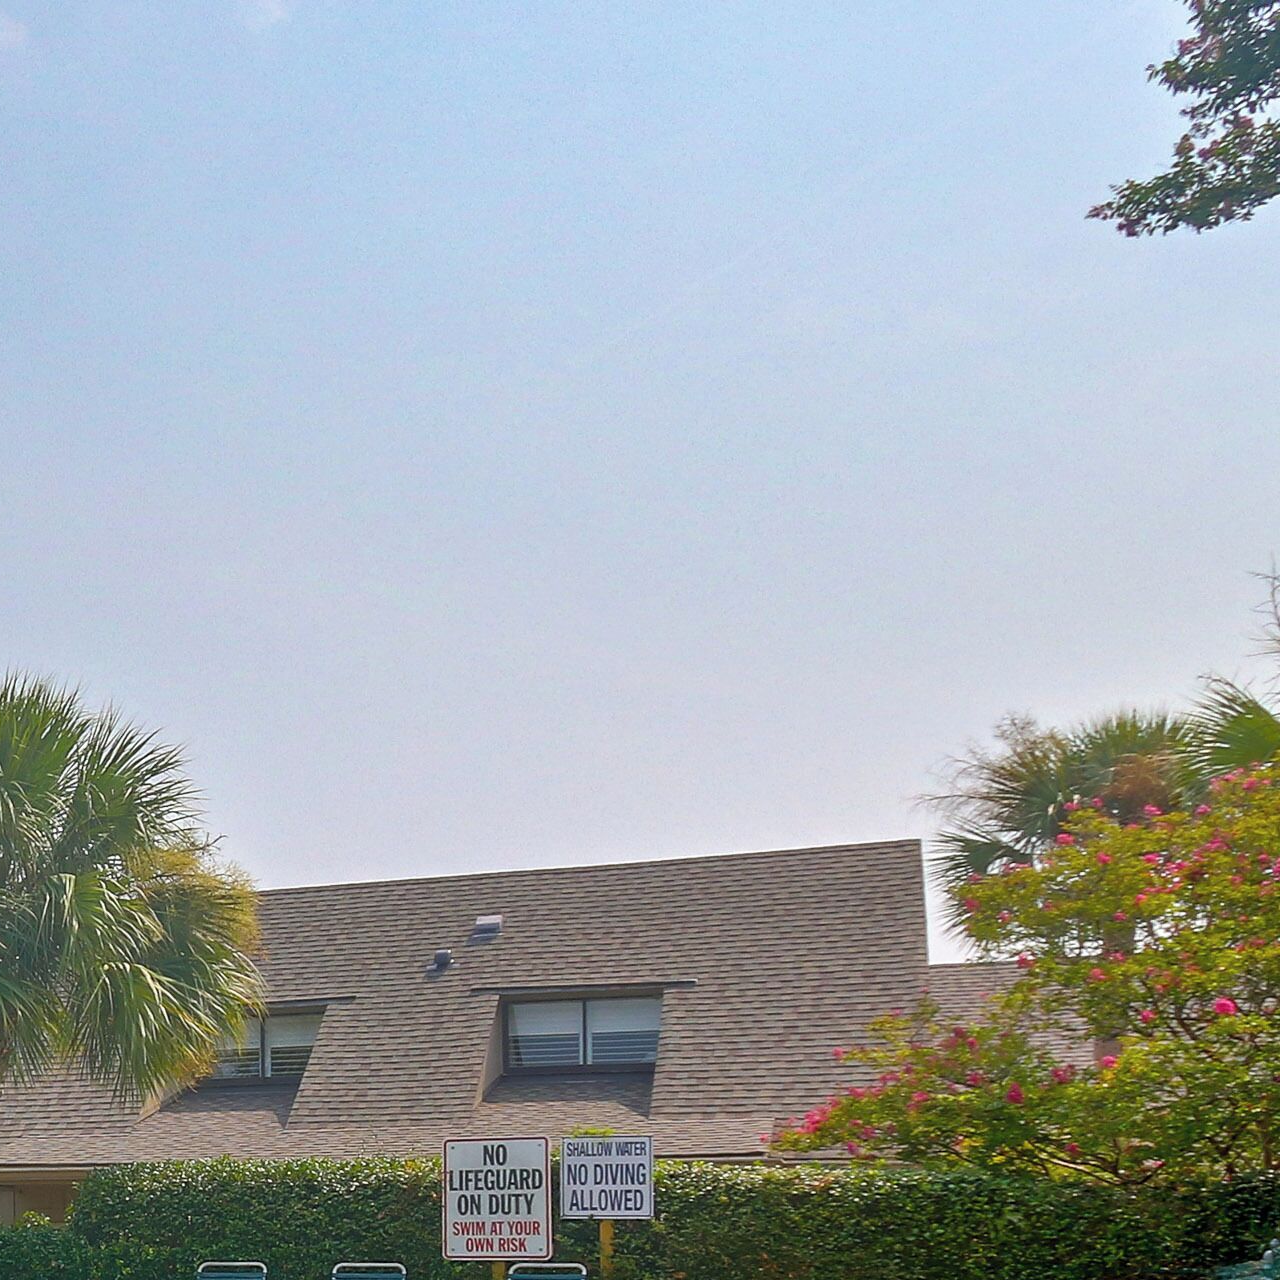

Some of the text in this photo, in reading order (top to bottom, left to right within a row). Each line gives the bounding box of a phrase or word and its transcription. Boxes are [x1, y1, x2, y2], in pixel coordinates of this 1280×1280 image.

[483, 1144, 508, 1166] NO
[566, 1141, 647, 1157] SHALLOW WATER
[448, 1169, 543, 1192] LIFEGUARD
[567, 1163, 647, 1186] NO DIVING
[457, 1193, 535, 1215] ON DUTY
[569, 1190, 644, 1212] ALLOWED
[452, 1220, 541, 1236] SWIM AT YOUR
[465, 1237, 527, 1253] OWN RISK
